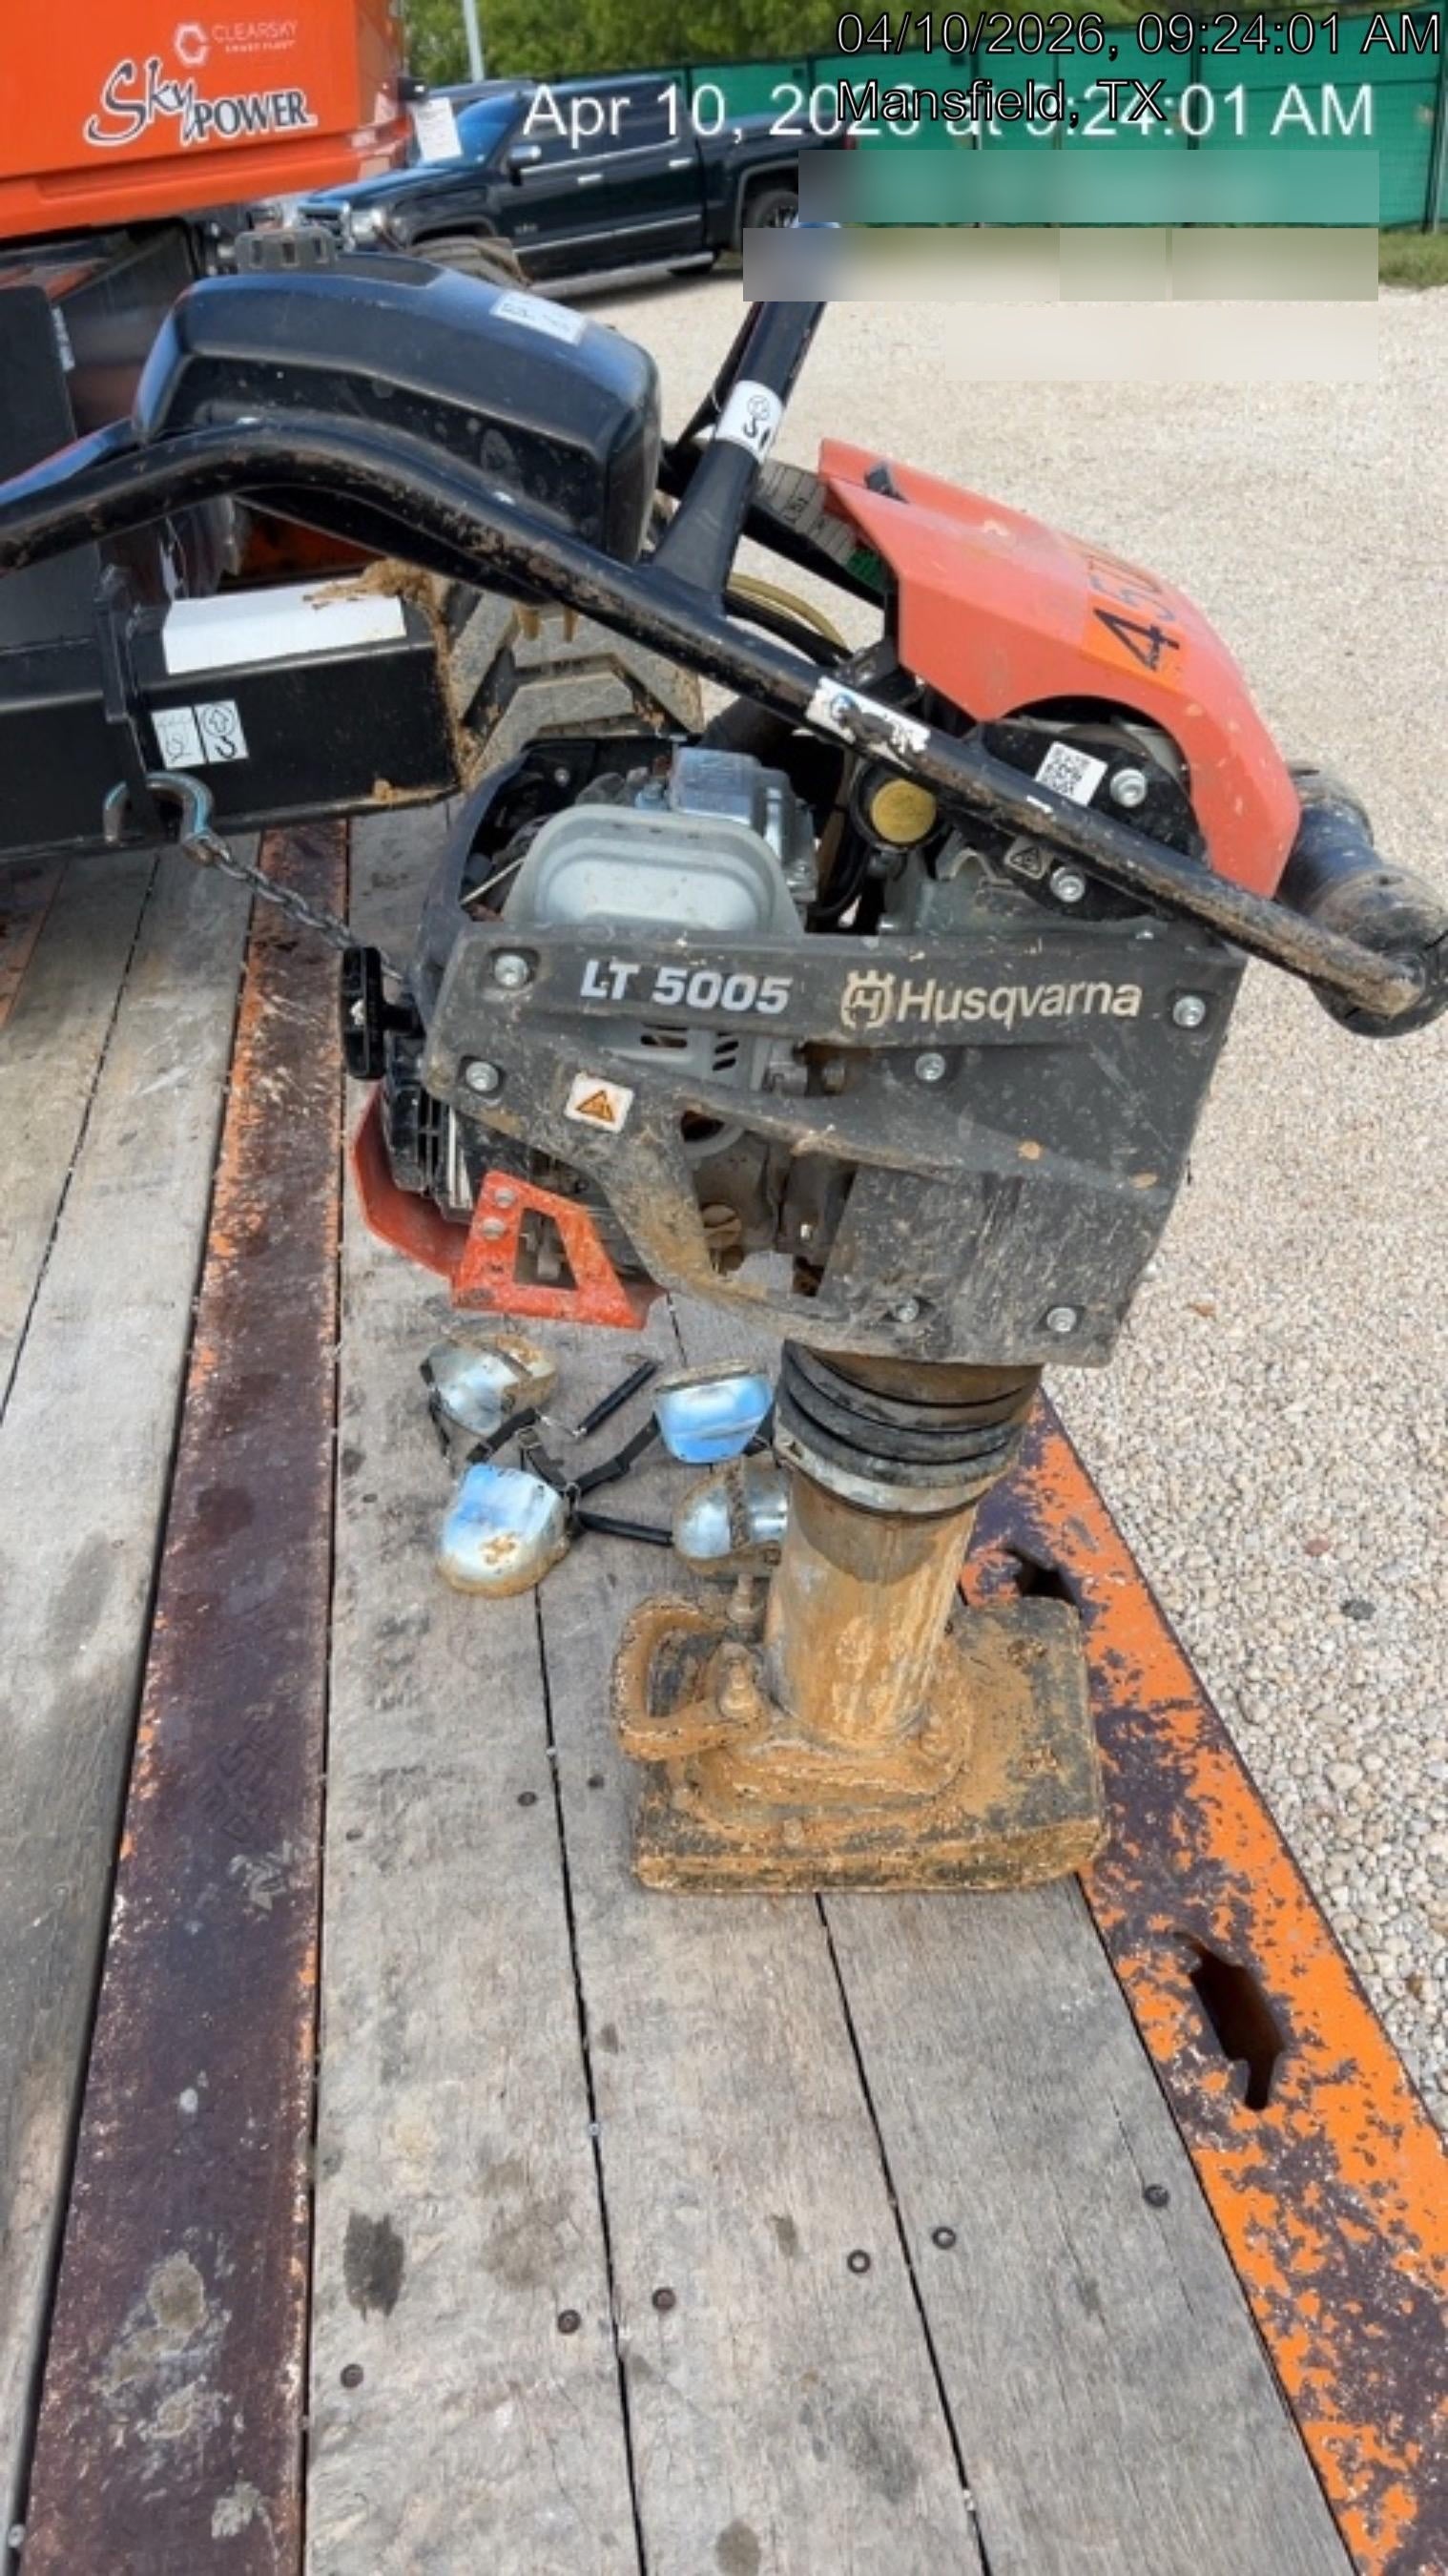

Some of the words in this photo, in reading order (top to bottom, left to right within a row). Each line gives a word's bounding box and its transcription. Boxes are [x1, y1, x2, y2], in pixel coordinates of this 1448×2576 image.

[211, 19, 299, 42] CLEARSKY
[84, 56, 197, 146] Sky
[192, 90, 314, 140] POWER
[580, 959, 640, 1000] LT
[652, 966, 794, 1015] 5005
[896, 977, 1143, 1031] Husqvarna
